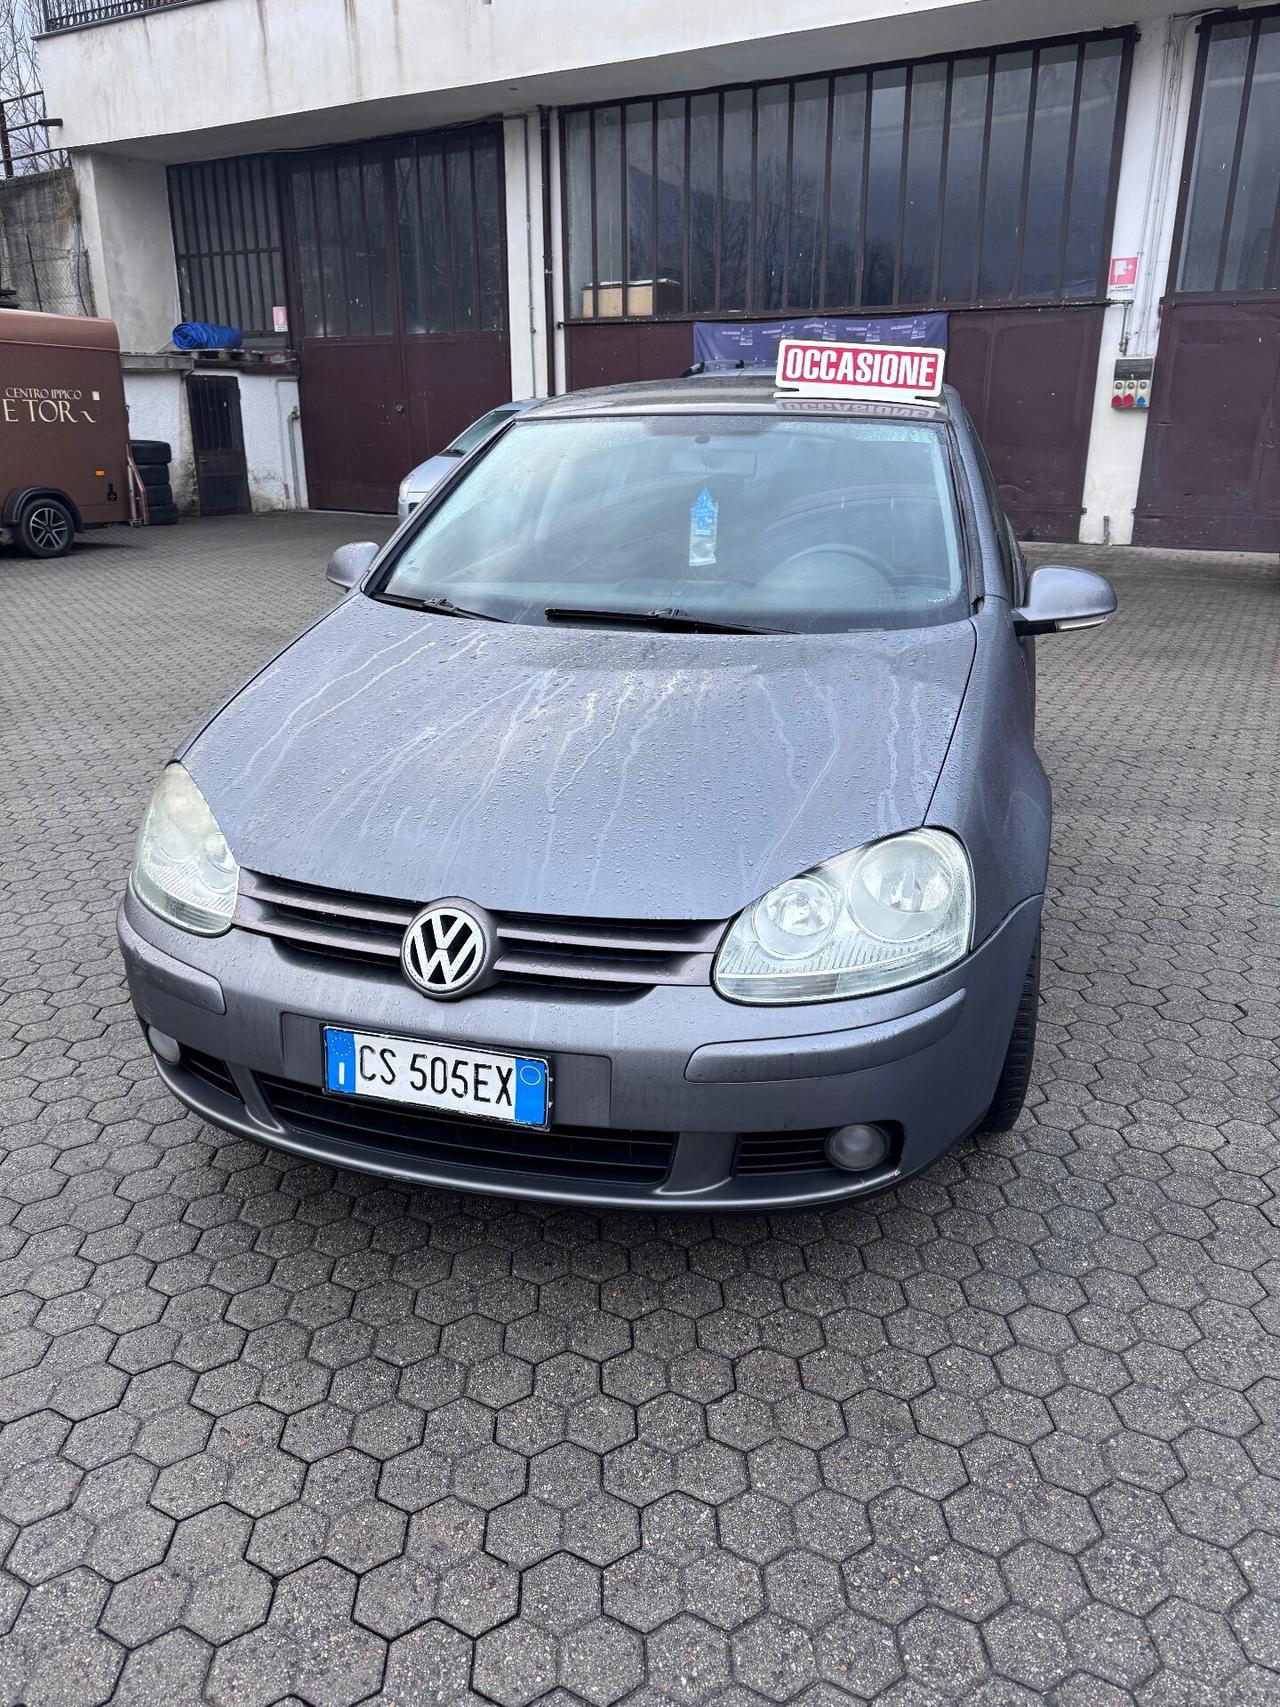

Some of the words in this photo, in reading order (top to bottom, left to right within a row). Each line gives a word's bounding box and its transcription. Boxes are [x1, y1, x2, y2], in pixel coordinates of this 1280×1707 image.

[785, 348, 936, 387] OCCASIONE
[5, 387, 49, 399] CENTRO
[50, 389, 82, 400] IPPICO
[406, 909, 482, 989] VW
[358, 1044, 397, 1085] CS
[409, 1053, 514, 1107] 505EX
